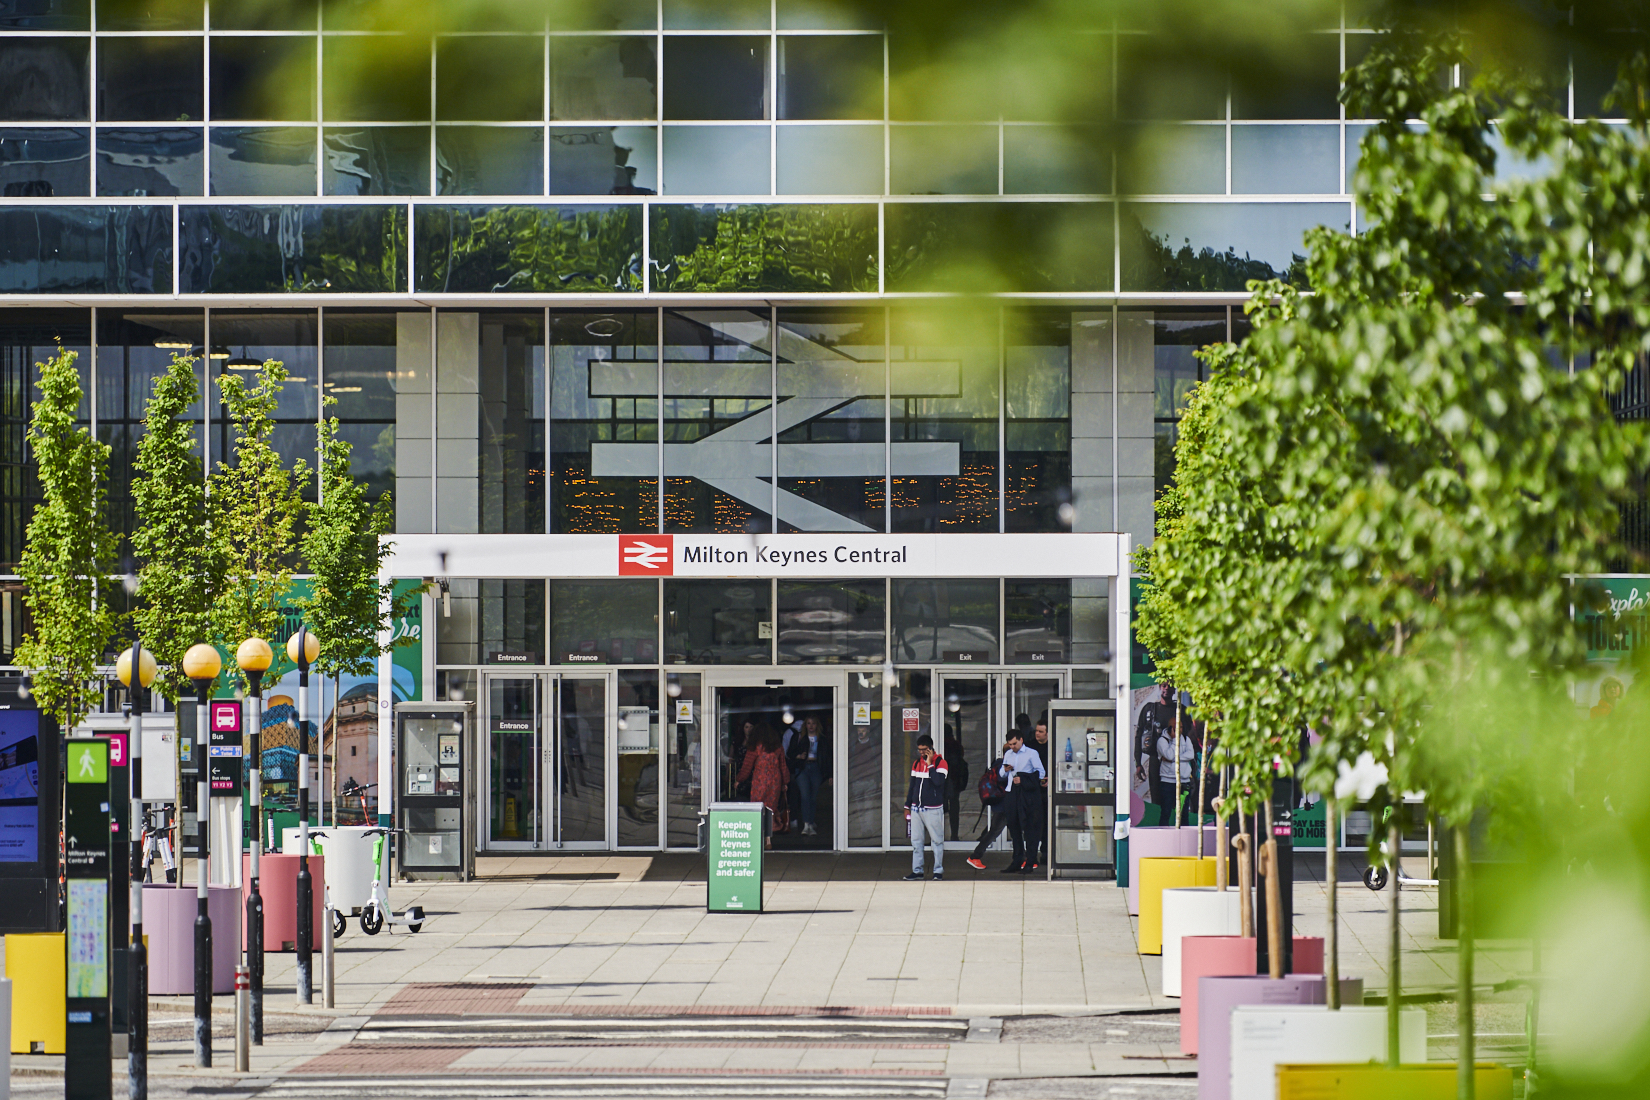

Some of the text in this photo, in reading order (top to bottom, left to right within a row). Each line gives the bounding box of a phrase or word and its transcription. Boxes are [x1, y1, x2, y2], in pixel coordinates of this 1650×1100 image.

[683, 546, 907, 567] Milton Keynes Central
[1597, 588, 1650, 622] xplo
[718, 821, 752, 830] Keeping
[721, 830, 749, 839] Milton
[1306, 828, 1326, 838] MOR
[721, 840, 751, 849] Keynes
[718, 860, 751, 868] greener
[716, 868, 755, 877] and safer
